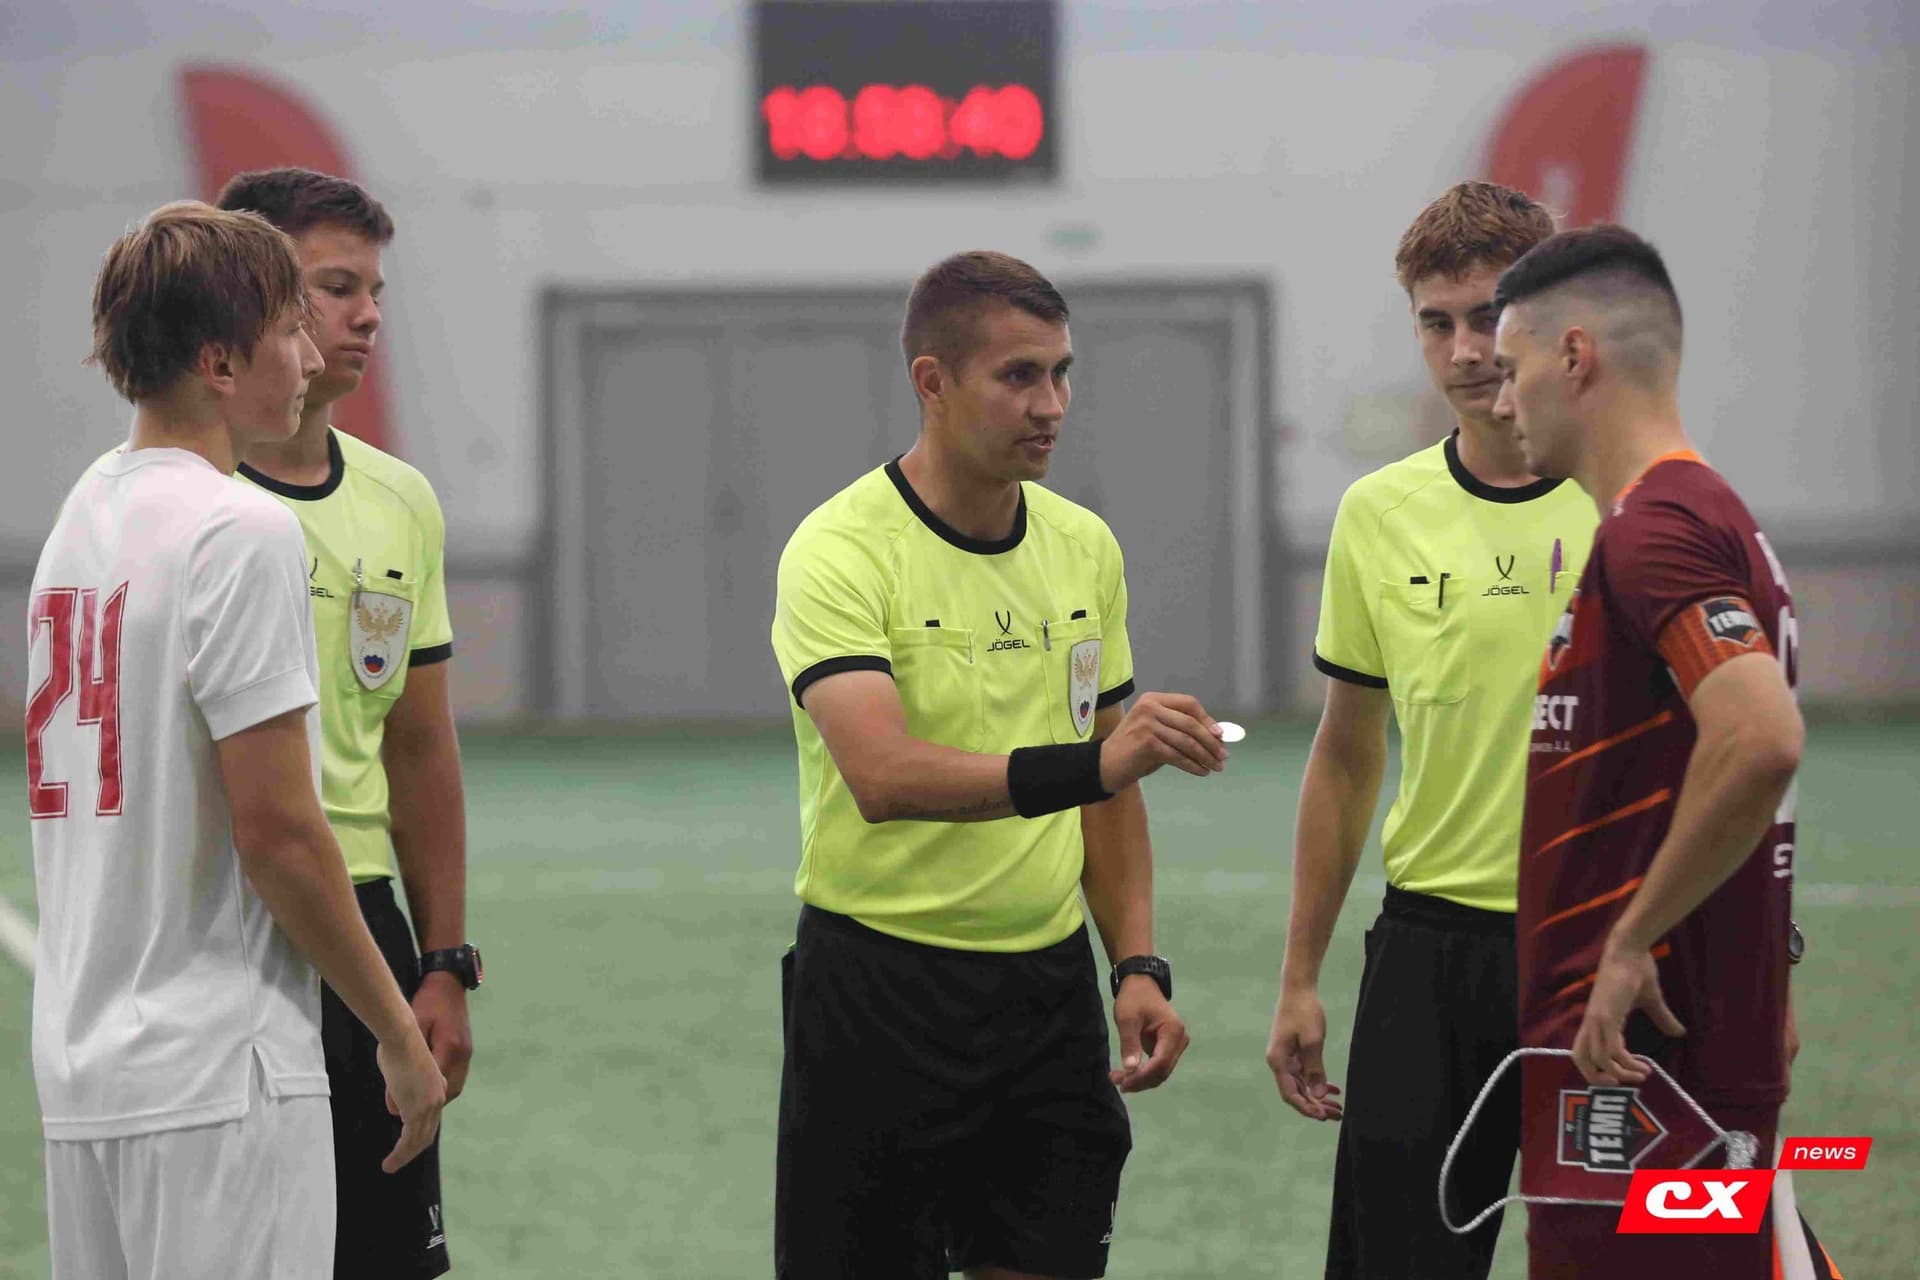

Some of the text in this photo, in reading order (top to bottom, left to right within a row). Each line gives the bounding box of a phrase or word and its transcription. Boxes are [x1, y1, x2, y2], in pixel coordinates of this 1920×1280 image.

[1481, 585, 1530, 597] JÖGEL
[987, 639, 1030, 652] JÖGEL
[25, 580, 129, 819] 24
